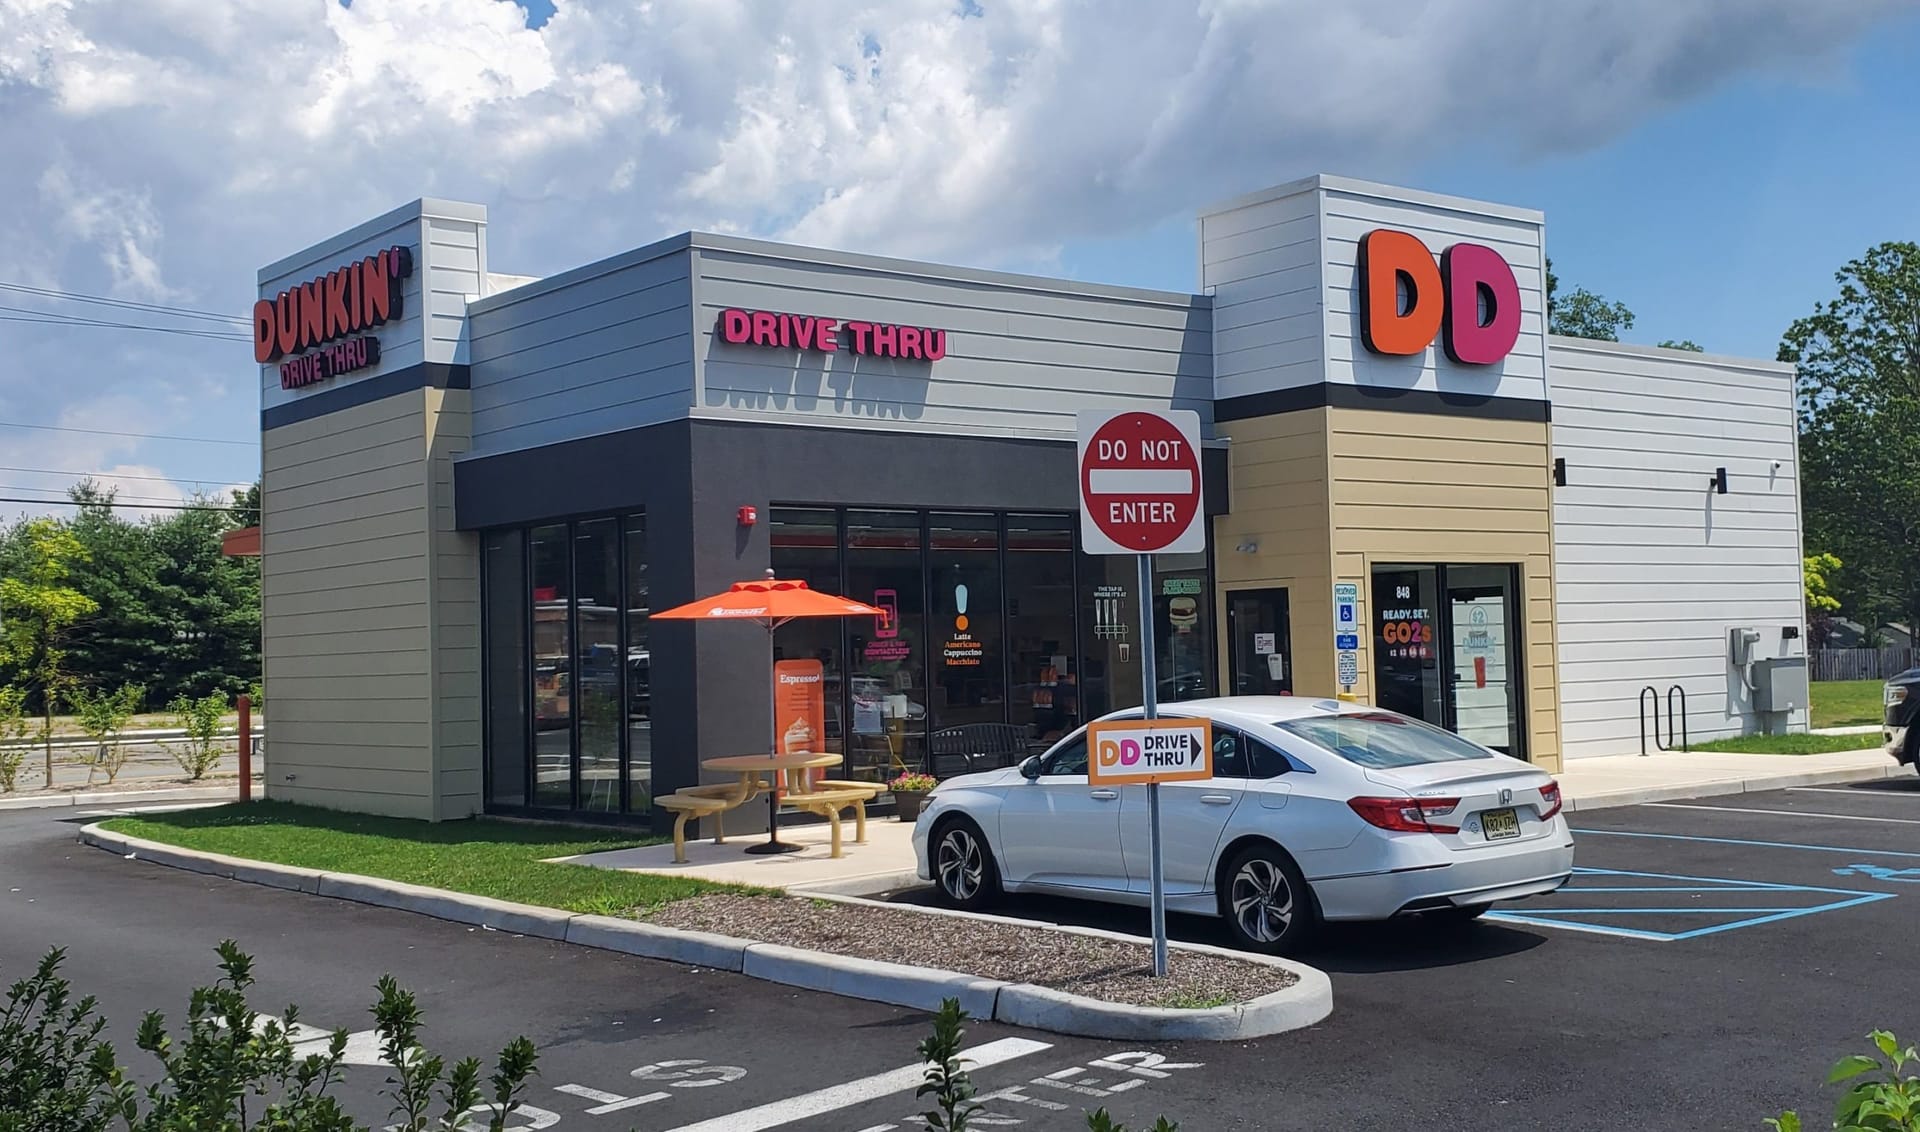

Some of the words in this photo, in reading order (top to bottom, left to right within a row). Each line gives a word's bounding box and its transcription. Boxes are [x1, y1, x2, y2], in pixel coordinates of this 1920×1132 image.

[254, 245, 402, 363] DUNKIN'
[725, 308, 839, 352] DRIVE
[848, 320, 946, 361] THRU
[280, 352, 322, 390] DRIVE
[325, 337, 368, 376] THRU
[1099, 440, 1127, 461] DO
[1141, 440, 1181, 461] NOT
[1109, 502, 1176, 523] ENTER
[1396, 586, 1410, 599] 848
[943, 649, 983, 658] Cappuccino
[946, 657, 981, 665] Macchiato
[1144, 734, 1188, 750] DRIVE
[1100, 739, 1141, 767] DD
[1144, 751, 1184, 767] THRU
